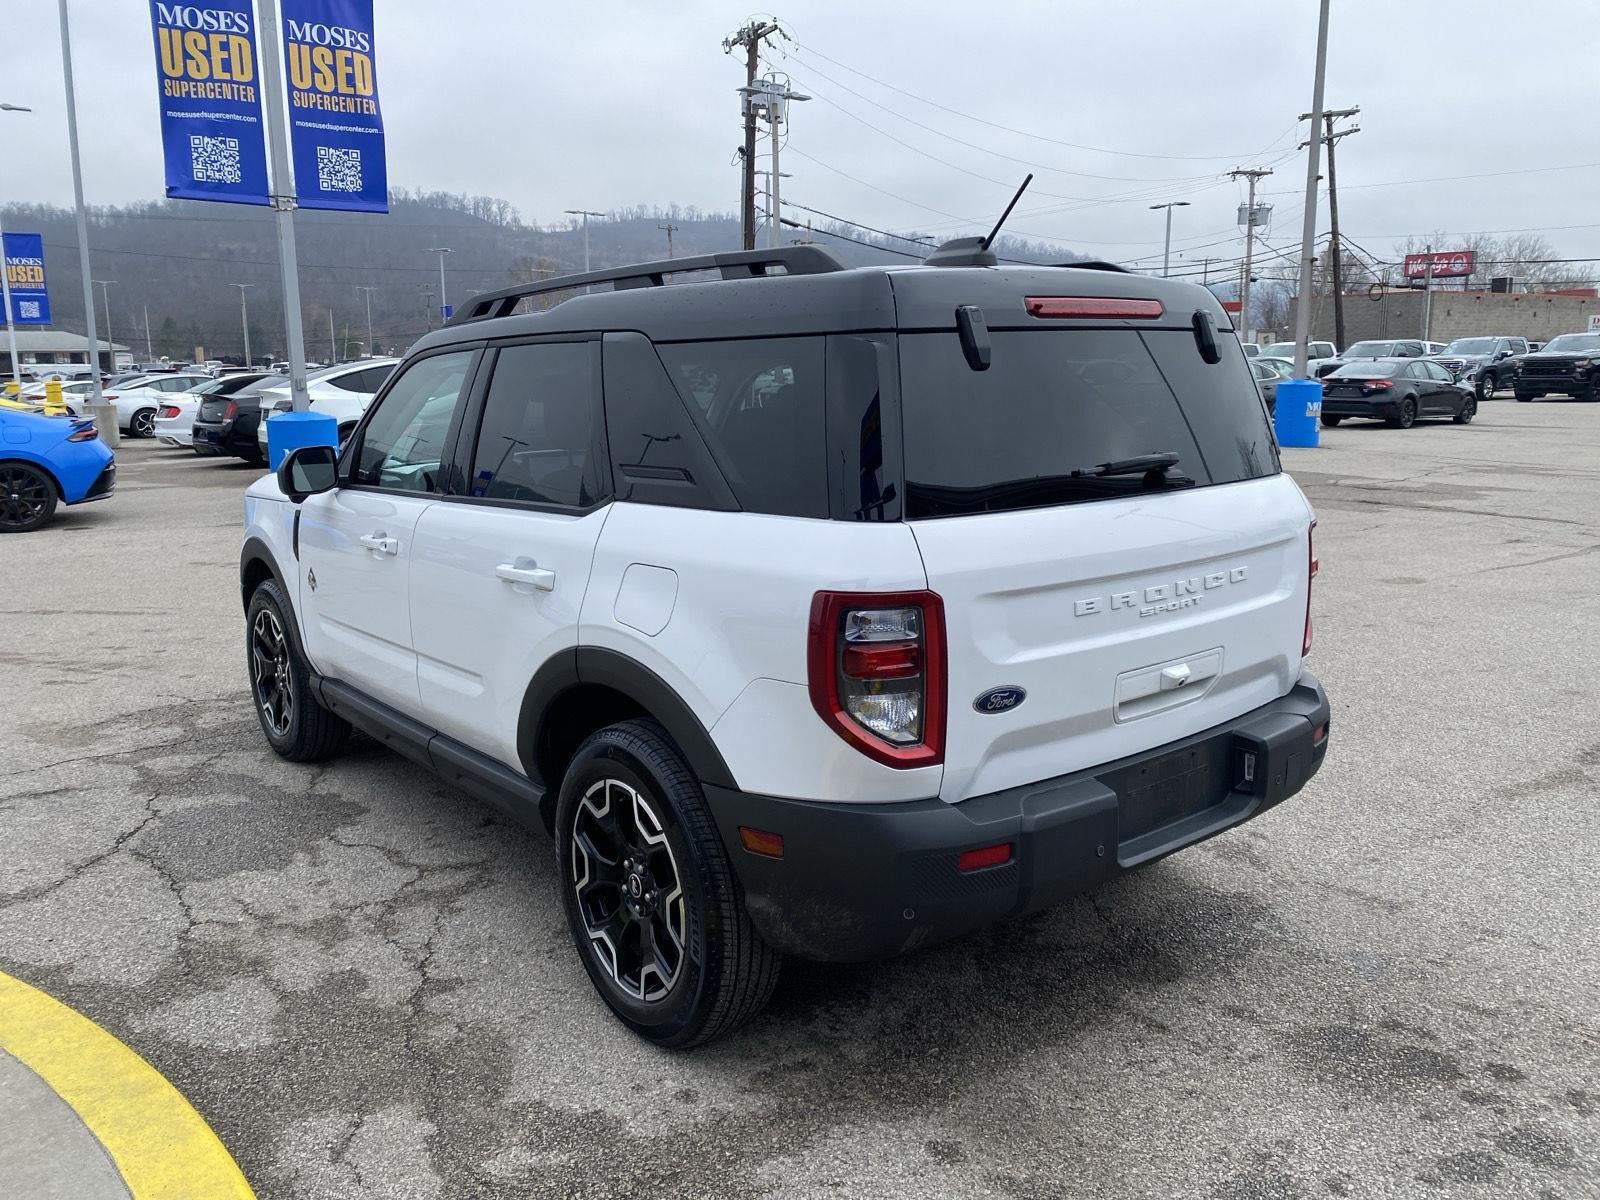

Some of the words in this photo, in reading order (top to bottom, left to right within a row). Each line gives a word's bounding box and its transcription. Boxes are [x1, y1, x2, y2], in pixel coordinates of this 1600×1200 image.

[156, 2, 249, 34] MOSES
[287, 19, 370, 53] MOSES
[159, 27, 253, 82] USED
[289, 42, 374, 97] USED
[164, 79, 255, 103] SUPERCENTER
[293, 90, 377, 115] SUPERCENTER
[167, 110, 257, 123] mosesusedsupercenter.com
[296, 120, 379, 134] mosesusedsupercenter.com
[6, 256, 42, 266] MOSES
[7, 265, 44, 283] USED
[1074, 566, 1249, 617] BRONCO
[1140, 595, 1204, 617] SPORT
[987, 692, 1016, 710] Ford
